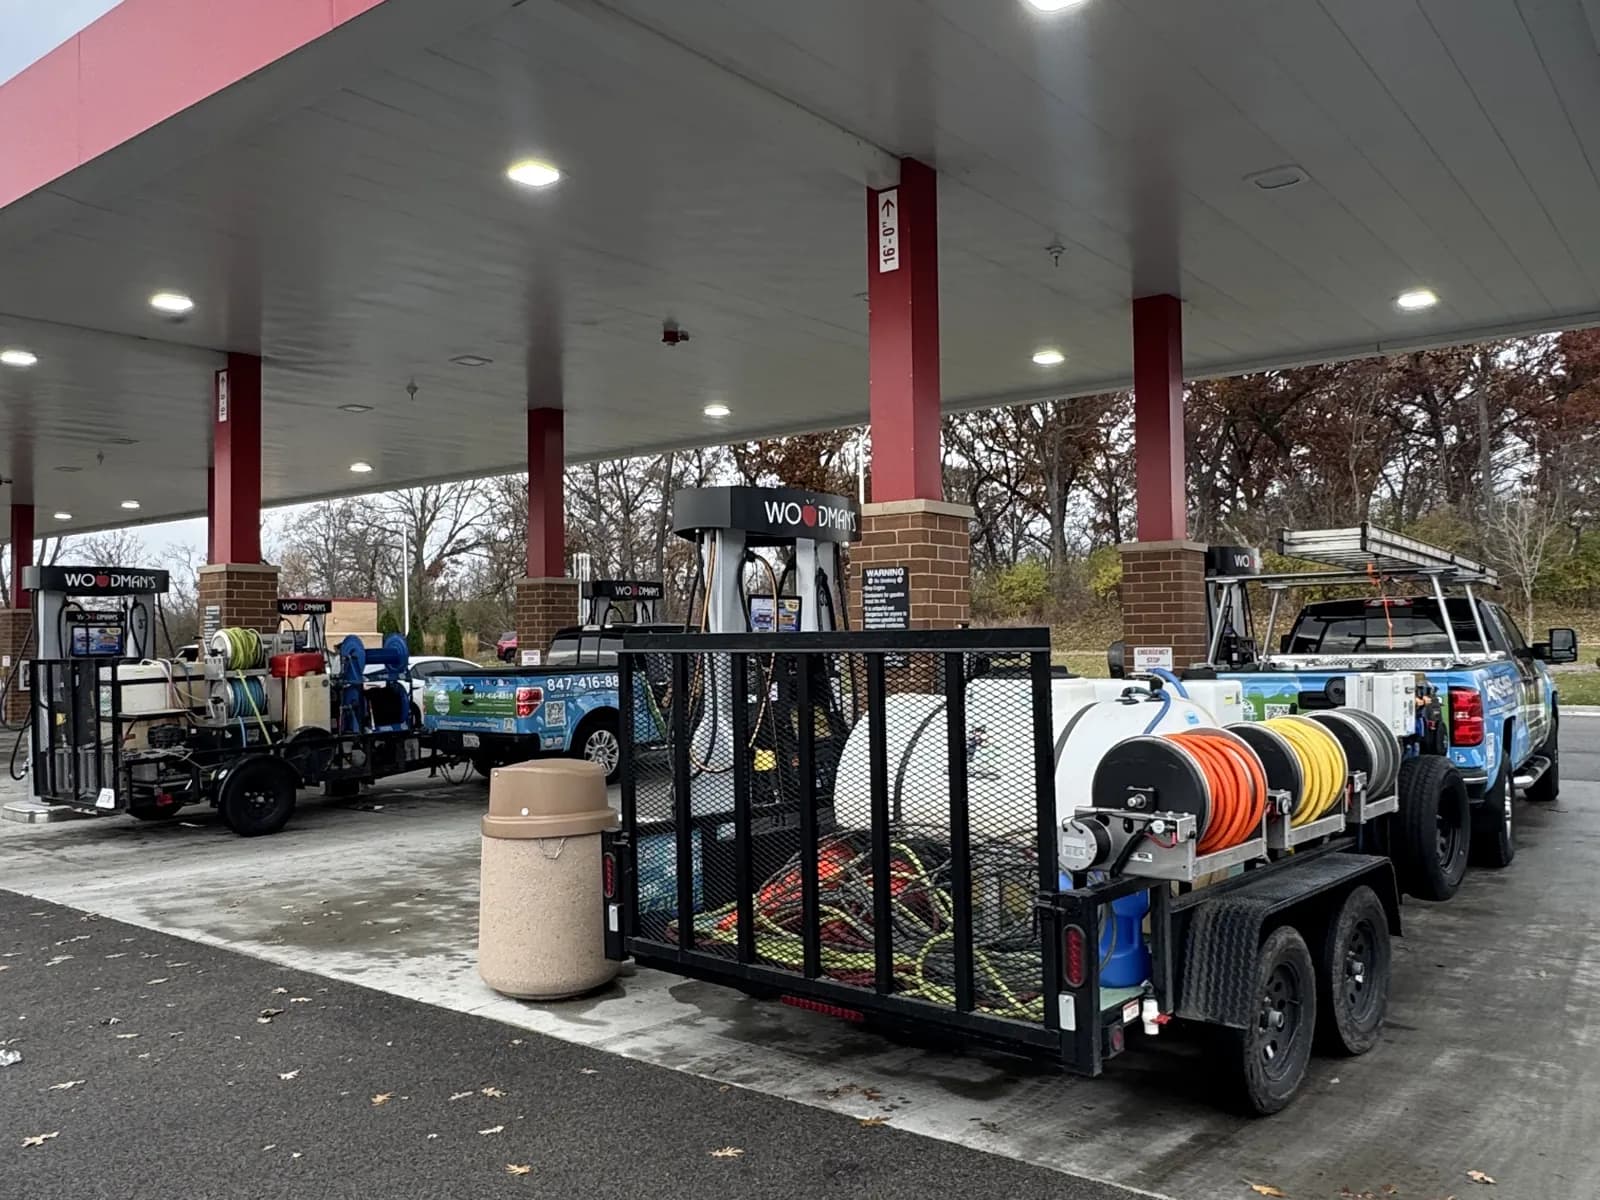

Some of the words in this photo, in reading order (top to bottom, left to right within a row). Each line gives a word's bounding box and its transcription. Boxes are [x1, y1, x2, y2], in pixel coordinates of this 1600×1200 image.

[764, 500, 857, 532] WOODMAN'S
[65, 571, 156, 589] WOODMAN'S
[866, 567, 904, 577] WARNING
[546, 675, 620, 692] 847-416-88
